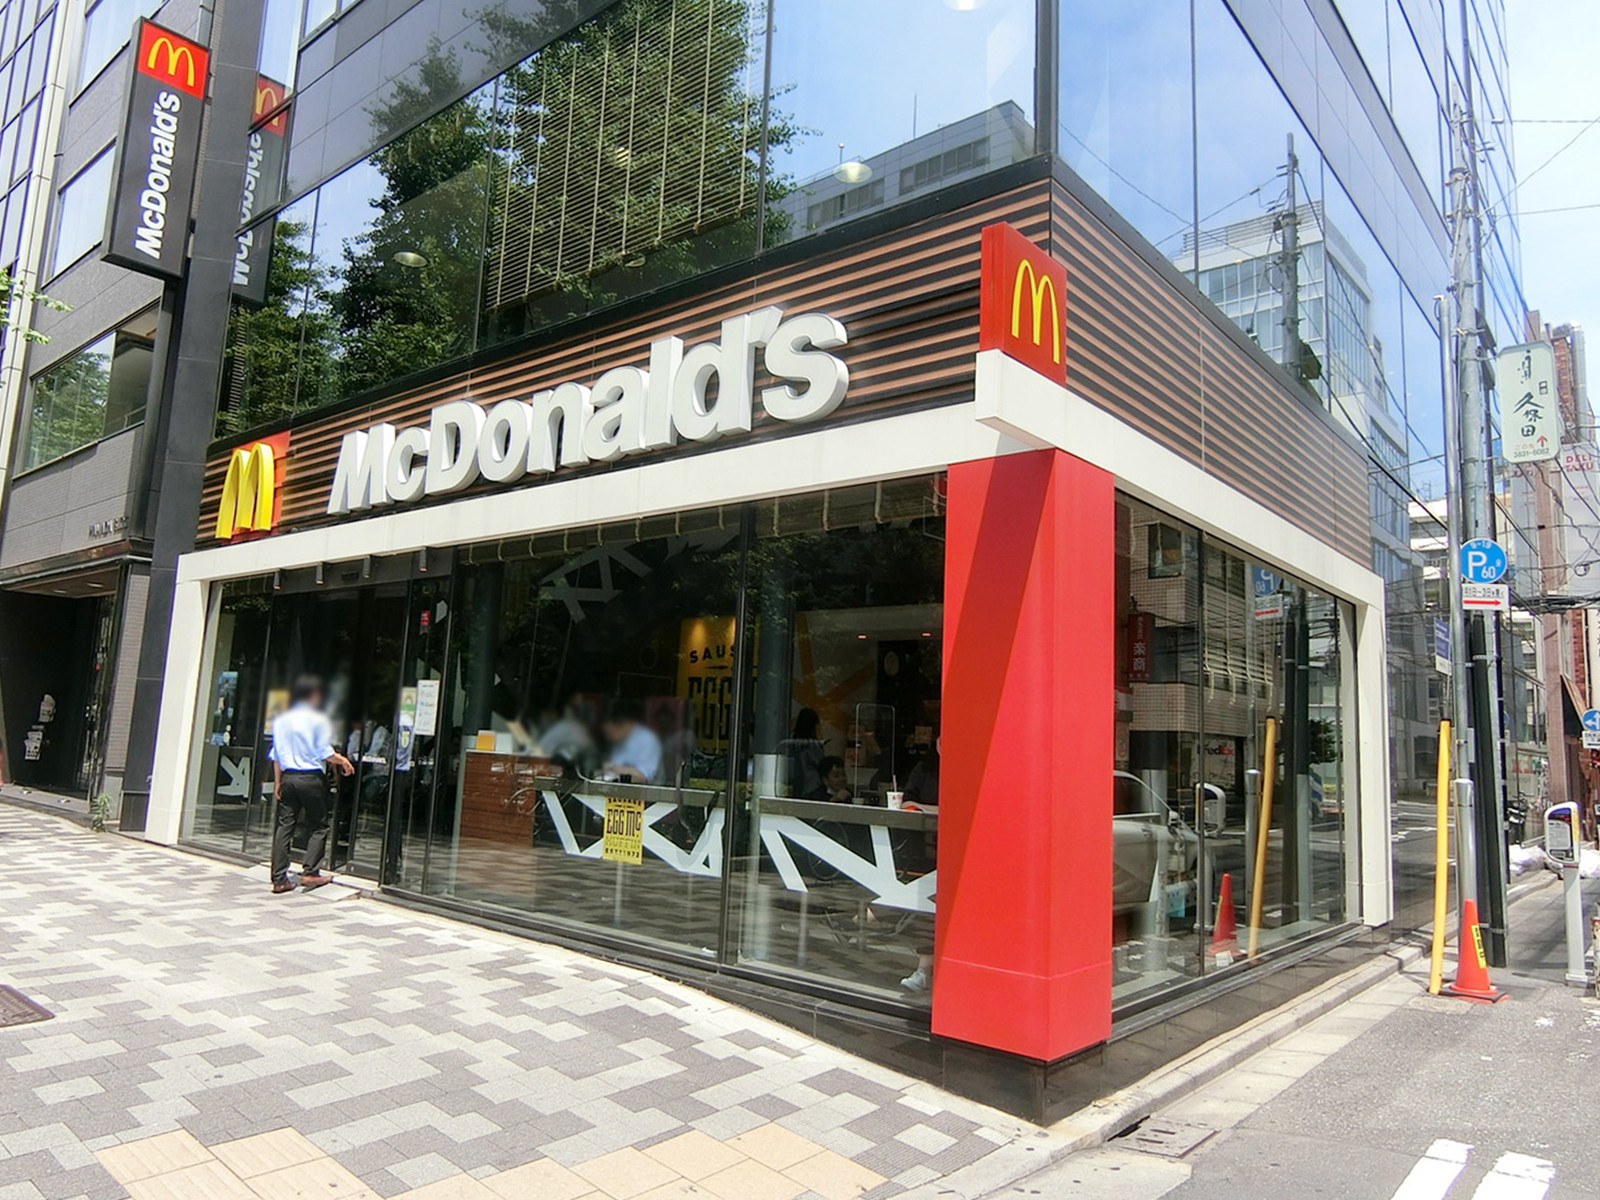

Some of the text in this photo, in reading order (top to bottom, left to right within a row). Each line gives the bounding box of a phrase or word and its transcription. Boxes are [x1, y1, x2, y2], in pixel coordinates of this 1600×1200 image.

[135, 91, 181, 260] McDonald's
[327, 305, 850, 516] McDonald's
[1513, 391, 1544, 437] 久保田
[1481, 566, 1496, 579] 60
[606, 809, 625, 835] EGG
